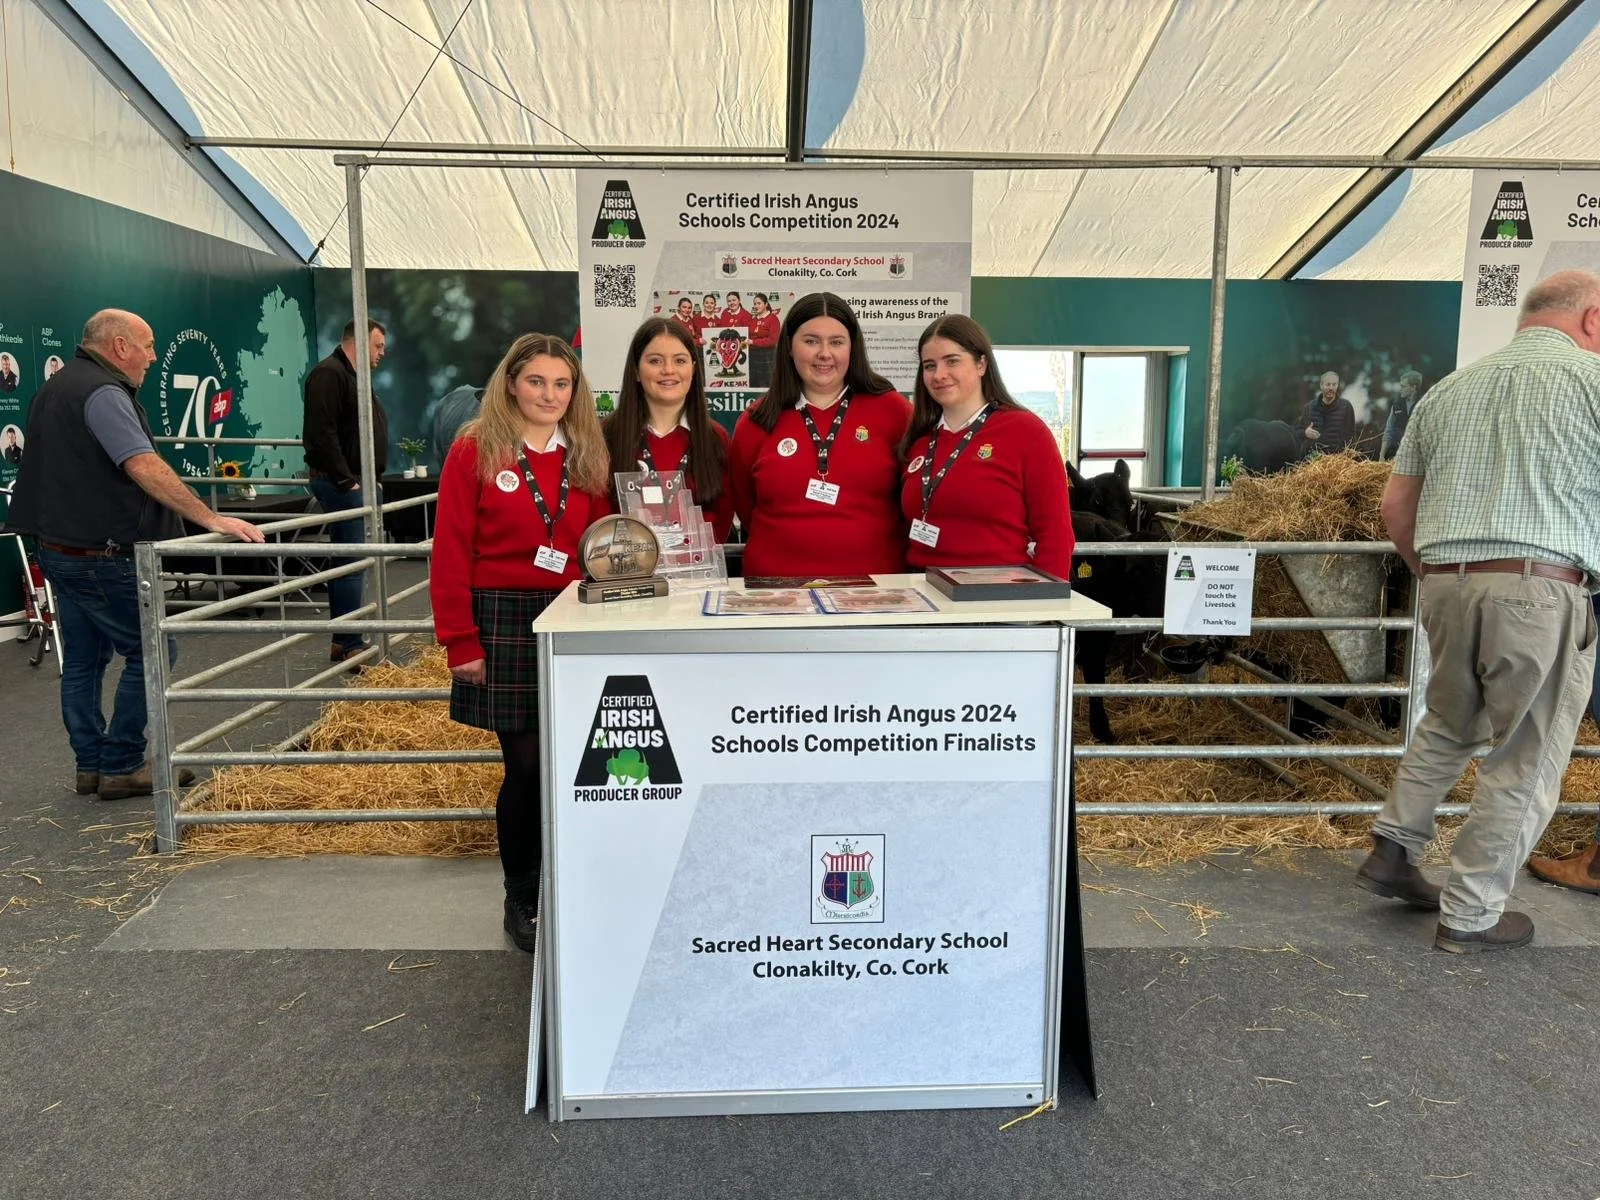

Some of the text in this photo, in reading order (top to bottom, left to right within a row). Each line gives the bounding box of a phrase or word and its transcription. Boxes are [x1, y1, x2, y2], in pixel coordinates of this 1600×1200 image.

[604, 198, 632, 208] IRISH
[686, 192, 859, 212] Certified Irish Angus
[1497, 199, 1524, 209] IRISH
[600, 208, 637, 219] ANGUS
[1490, 209, 1527, 220] ANGUS
[679, 212, 900, 232] Schools Competition 2024
[591, 240, 647, 248] PRODUCER GROUP
[741, 256, 885, 267] Sacred Heart Secondary School
[768, 267, 858, 279] Clonakilty, Co. Cork
[868, 298, 919, 306] awareness
[920, 297, 931, 306] of
[933, 297, 949, 306] the
[862, 310, 884, 319] Irish
[885, 310, 916, 321] Angus
[917, 310, 947, 319] Brand
[41, 327, 54, 337] ABP
[42, 337, 62, 347] Clones
[159, 328, 227, 437] CELEBRATING SEVENTY YEARS
[1205, 564, 1240, 572] WELCOME
[602, 695, 653, 707] CERTIFIED
[600, 709, 655, 728] IRISH
[731, 704, 1017, 727] Certified Irish Angus 2024
[591, 728, 664, 749] ANGUS
[711, 733, 1036, 756] Schools Competition Finalists
[574, 787, 683, 802] PRODUCER GROUP
[692, 932, 1008, 954] Sacred Heart Secondary School
[752, 958, 950, 981] Clonakilty, Co. Cork
